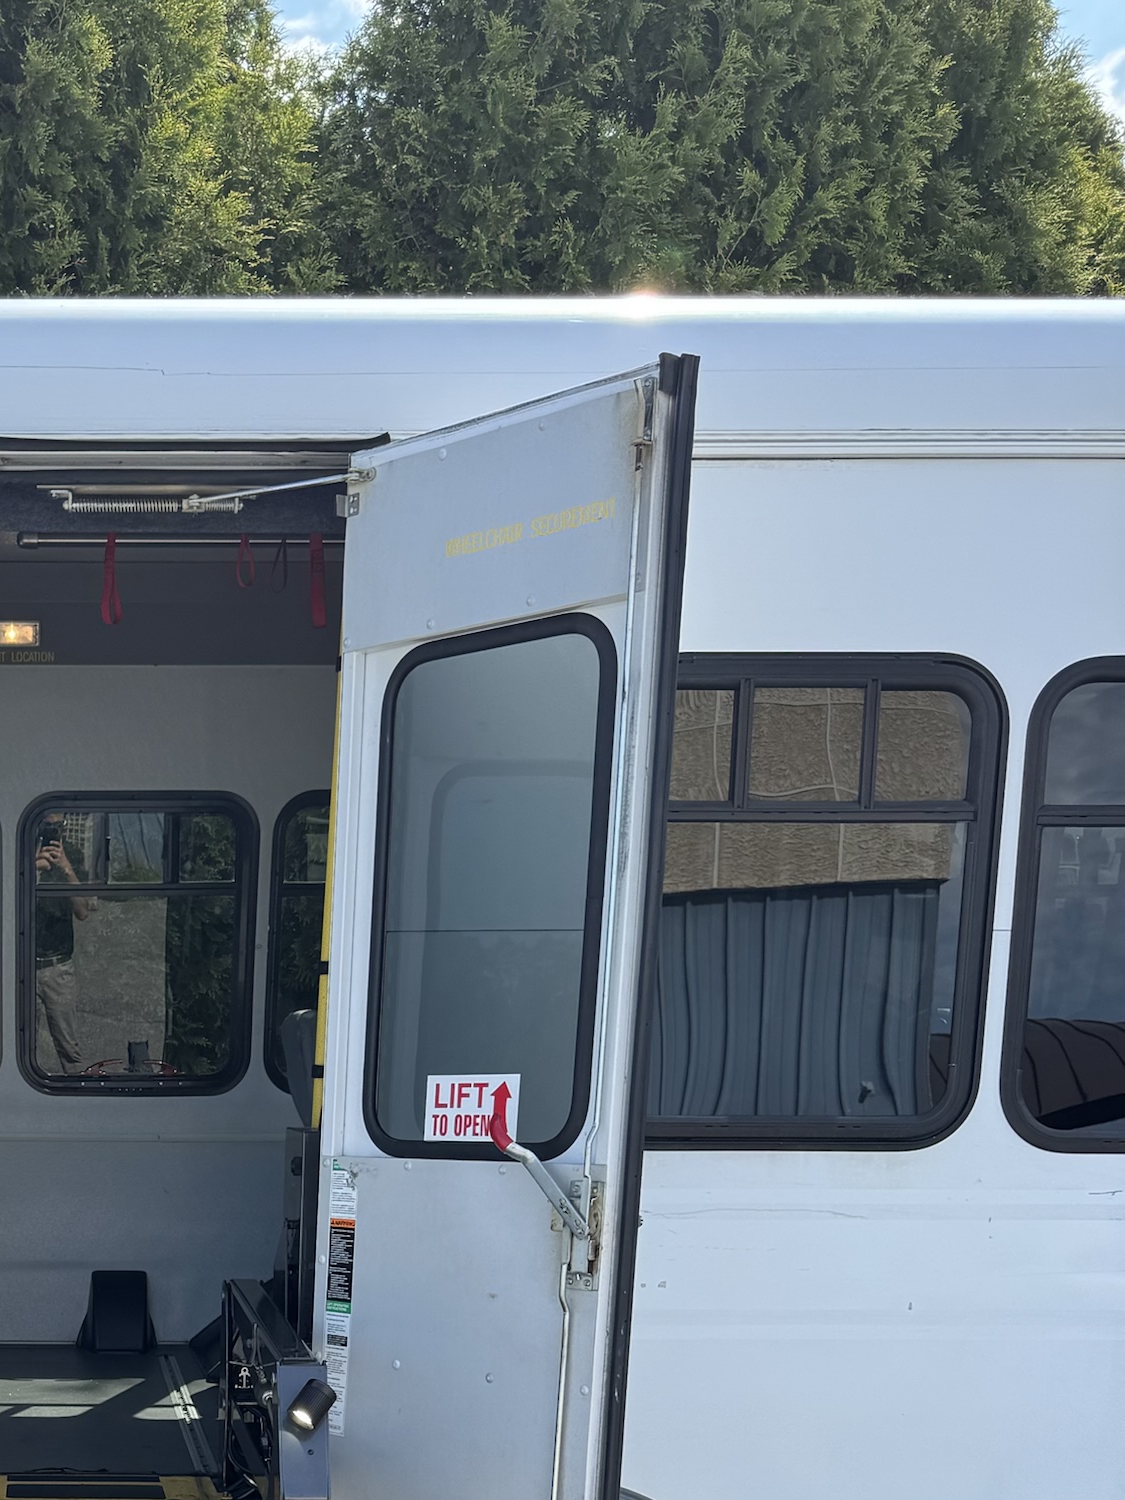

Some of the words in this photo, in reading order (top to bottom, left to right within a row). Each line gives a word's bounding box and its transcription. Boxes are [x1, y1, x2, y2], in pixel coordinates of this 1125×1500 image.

[445, 522, 523, 558] WHEELCHAIR
[529, 498, 616, 538] SECUREMENT
[11, 651, 55, 663] LOCATION
[434, 1083, 489, 1109] LIFT
[432, 1114, 448, 1136] TO
[454, 1114, 491, 1137] OPEN
